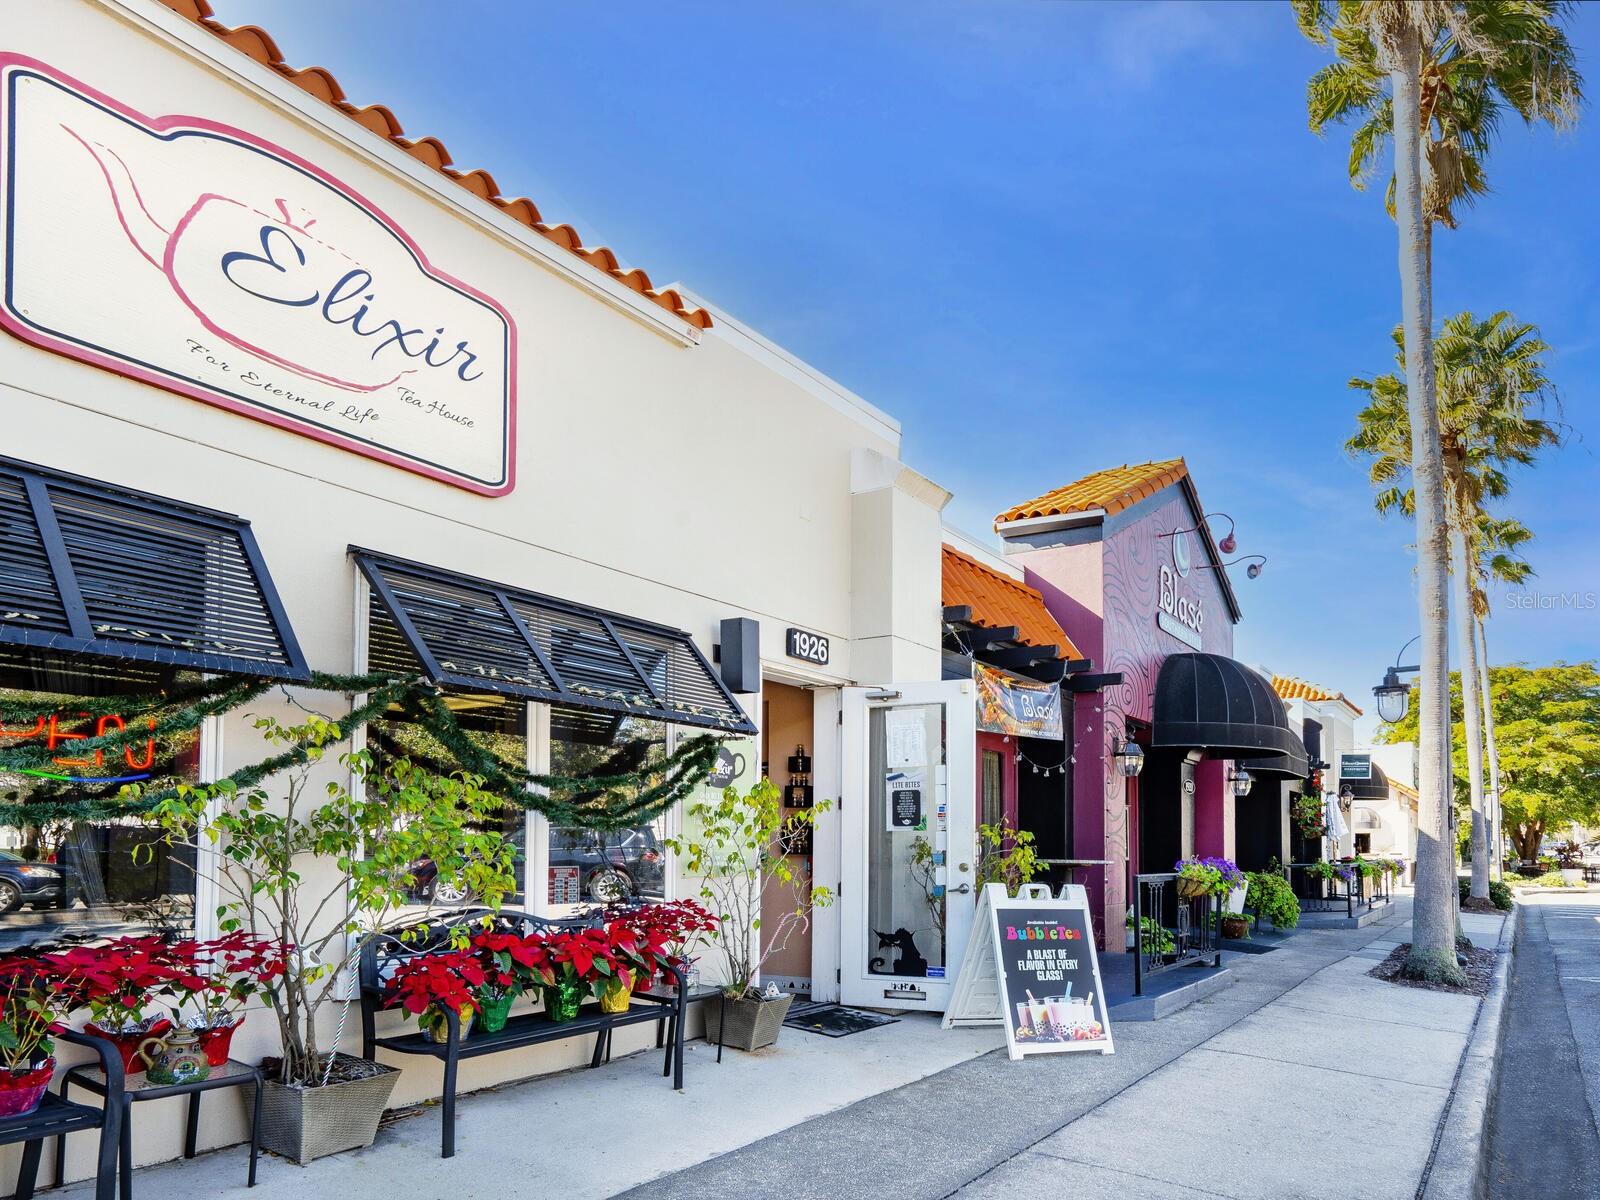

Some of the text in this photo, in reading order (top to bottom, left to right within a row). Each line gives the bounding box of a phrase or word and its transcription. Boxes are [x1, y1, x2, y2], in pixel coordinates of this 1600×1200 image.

[221, 225, 484, 382] Elixir
[186, 338, 380, 425] For Eternal Life
[397, 386, 475, 428] Tea House
[1158, 564, 1203, 633] Blasé
[793, 631, 828, 662] 1926
[1017, 959, 1078, 971] FLAVOR IN EVERY
[1027, 949, 1067, 960] A BLAST OF
[1036, 970, 1064, 981] GLASS!
